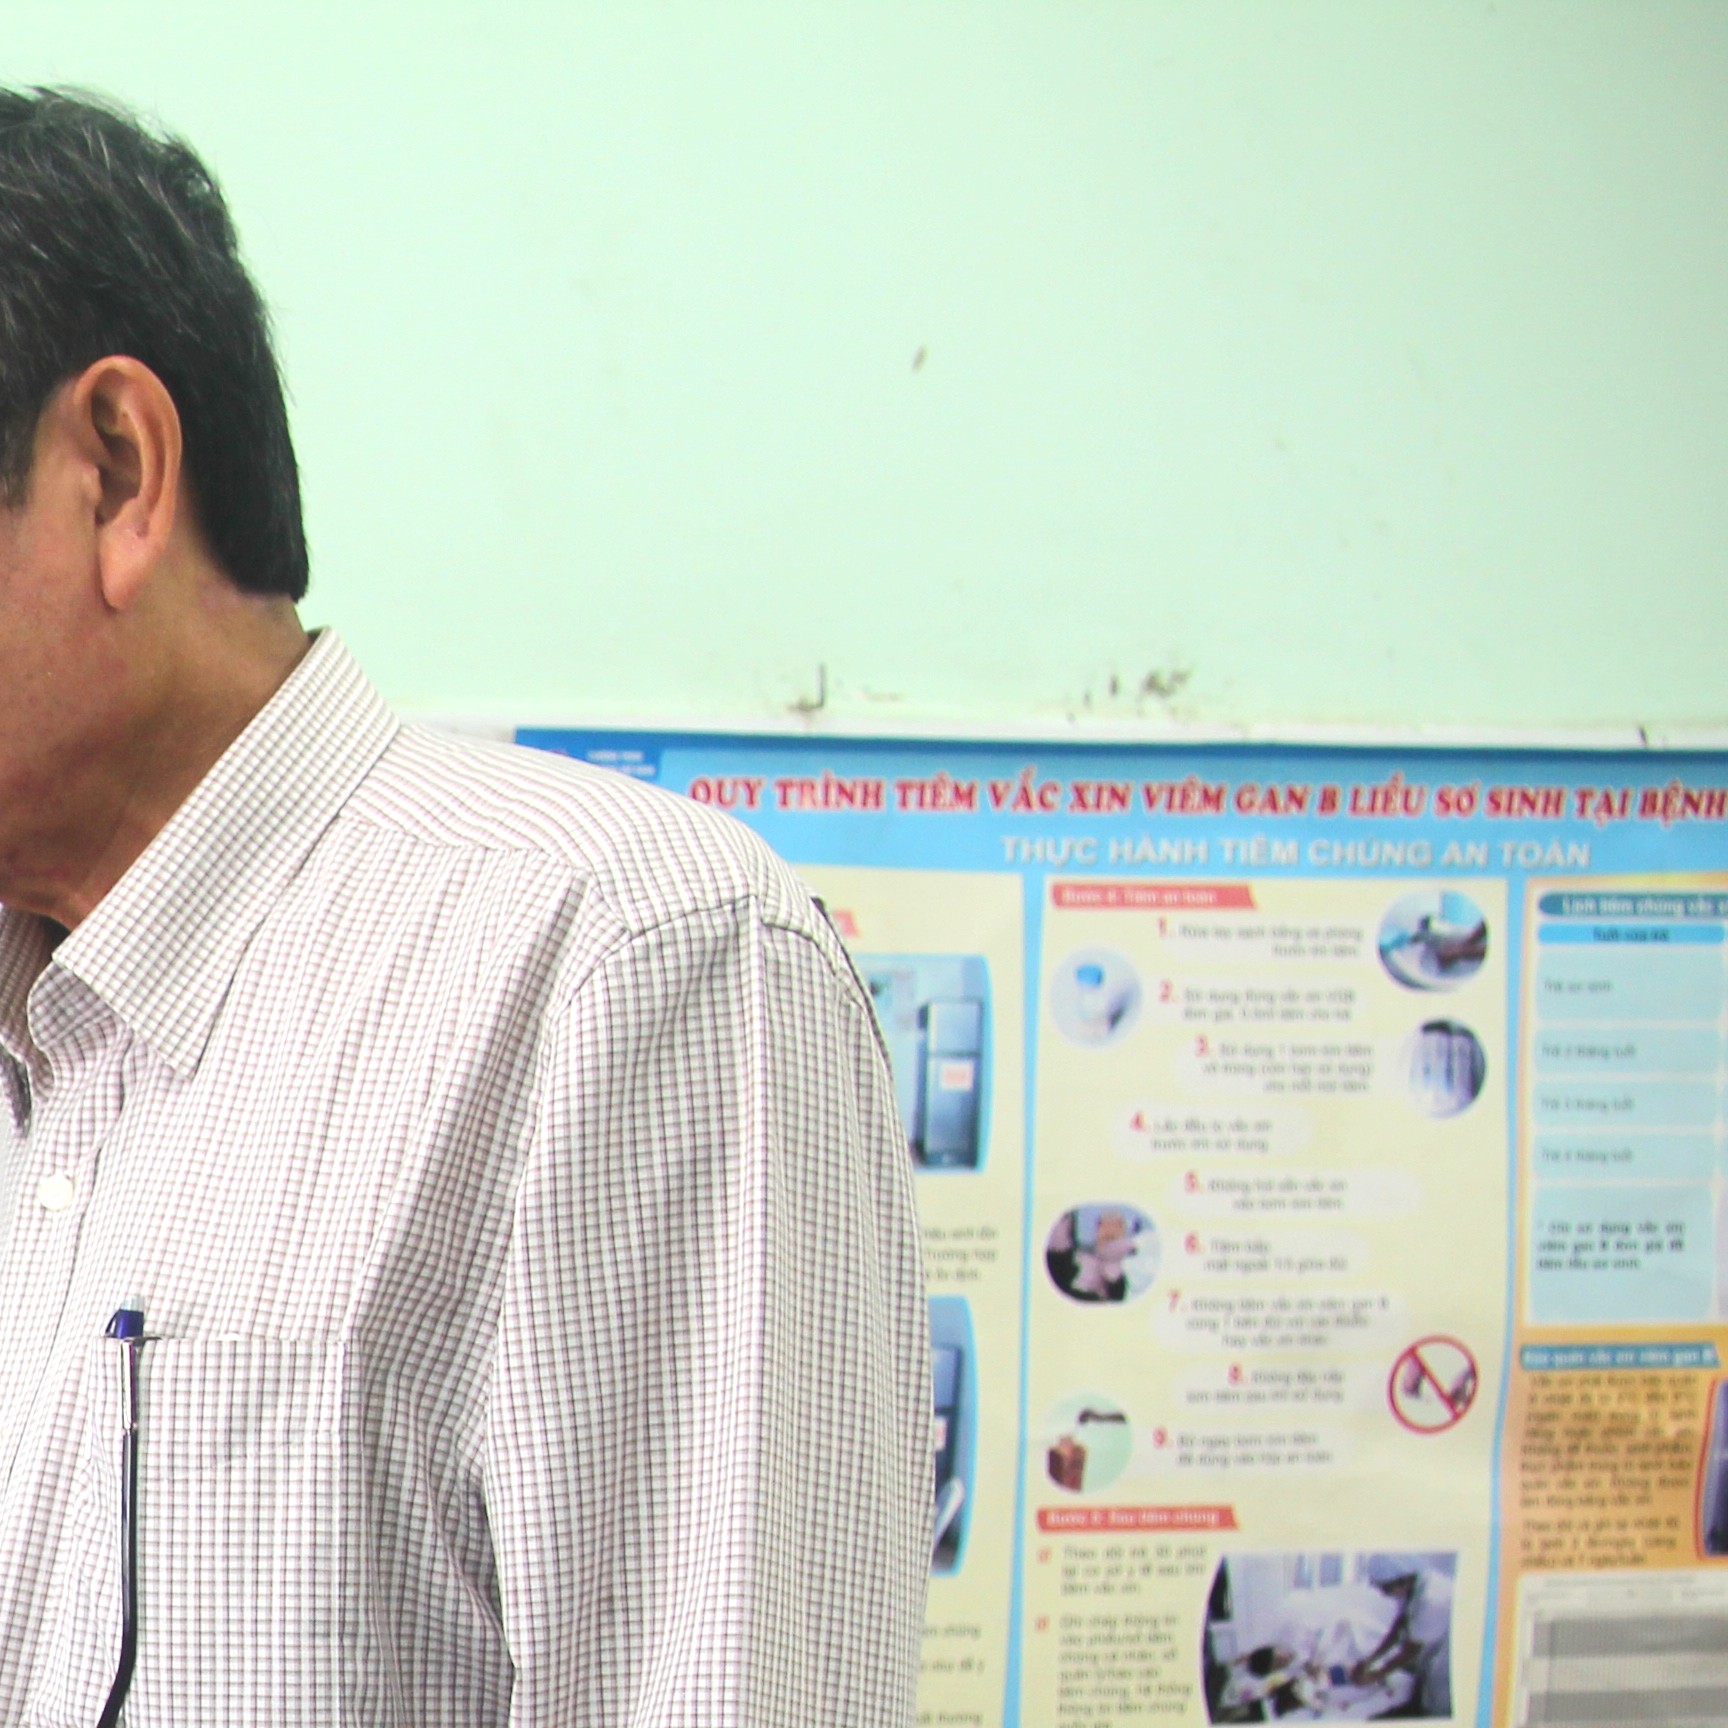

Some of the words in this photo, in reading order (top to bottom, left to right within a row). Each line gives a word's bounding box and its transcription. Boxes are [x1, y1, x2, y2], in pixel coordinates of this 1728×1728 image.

[689, 776, 763, 809] QUY
[774, 770, 884, 811] TRÌNH
[895, 772, 980, 811] TIÊM
[989, 765, 1061, 812] VẮC
[1068, 779, 1133, 813] XIN
[1142, 773, 1228, 816] VIÊM
[1234, 782, 1311, 817] GAN
[1316, 784, 1341, 816] B
[1433, 779, 1481, 817] SƠ
[1484, 785, 1566, 818] SINH
[1573, 785, 1632, 828] TẠI
[1638, 778, 1728, 828] BỆNH
[1001, 836, 1099, 867] THỰC
[1220, 833, 1300, 866] TIÊM
[1441, 840, 1489, 868] AN
